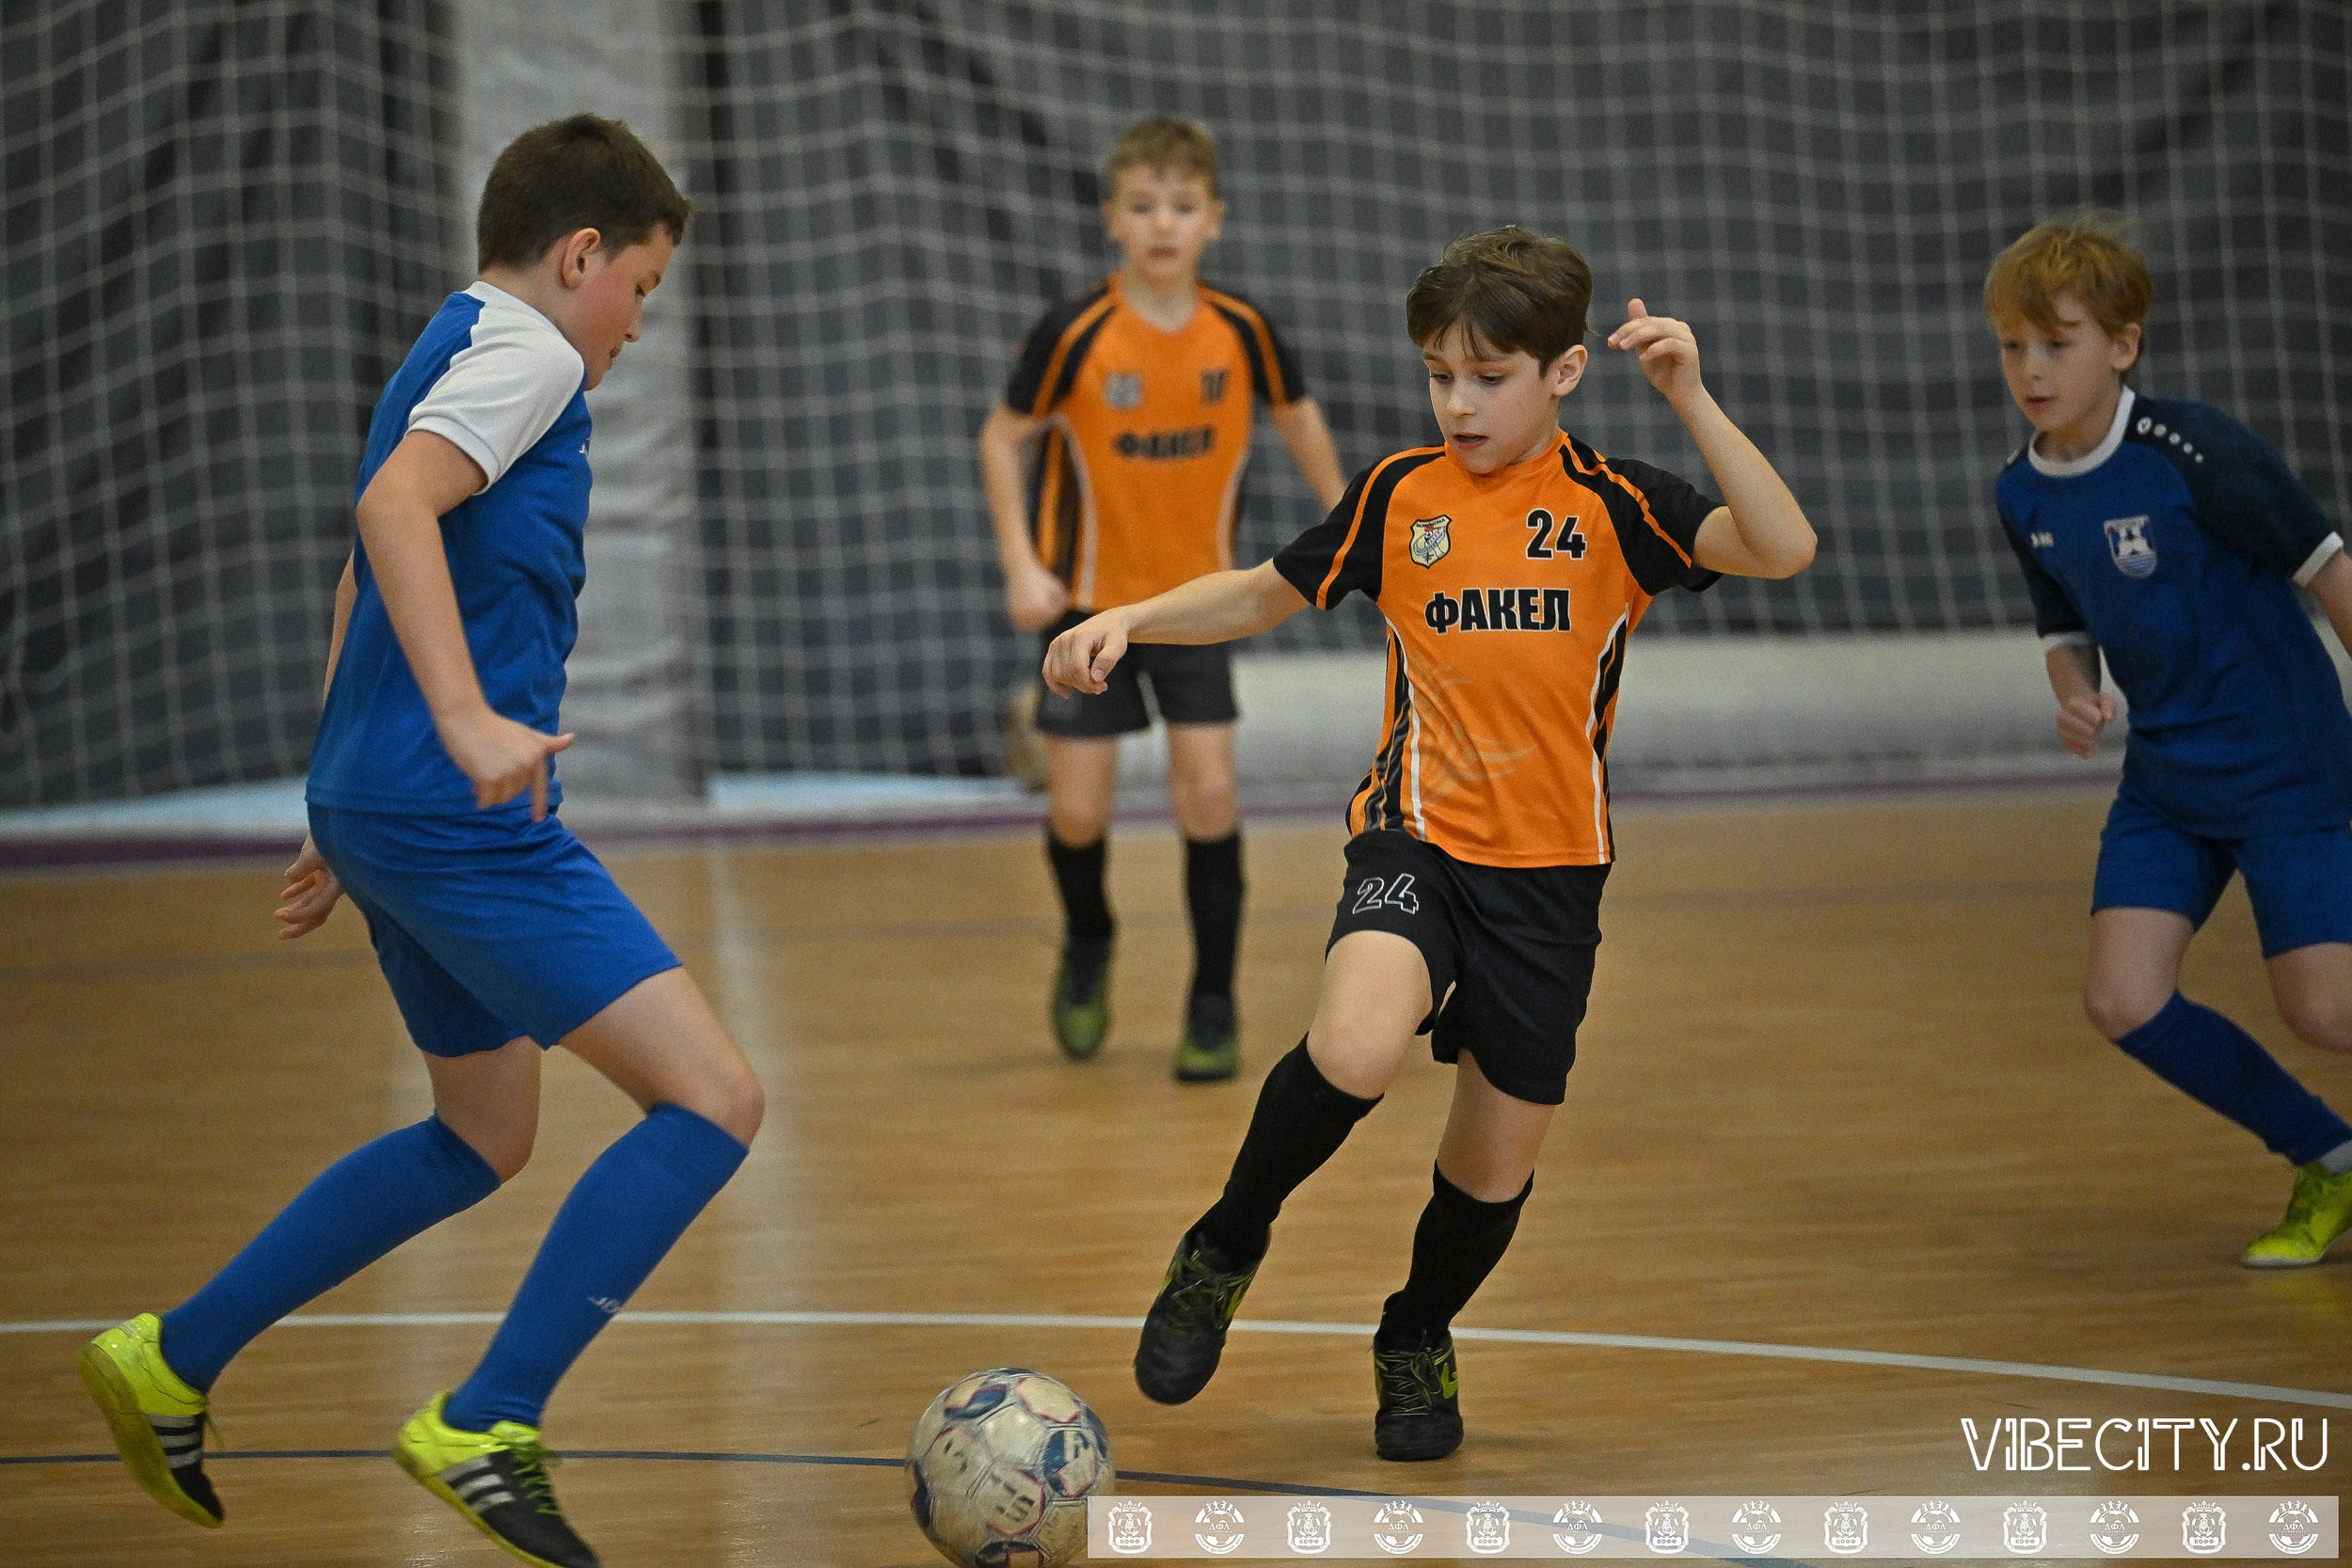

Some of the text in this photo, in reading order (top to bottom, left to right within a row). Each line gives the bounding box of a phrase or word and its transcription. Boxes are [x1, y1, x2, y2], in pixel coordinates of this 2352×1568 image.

[1526, 508, 1587, 561] 24
[1424, 587, 1572, 635] ФАКЕЛ
[1352, 873, 1420, 915] 24
